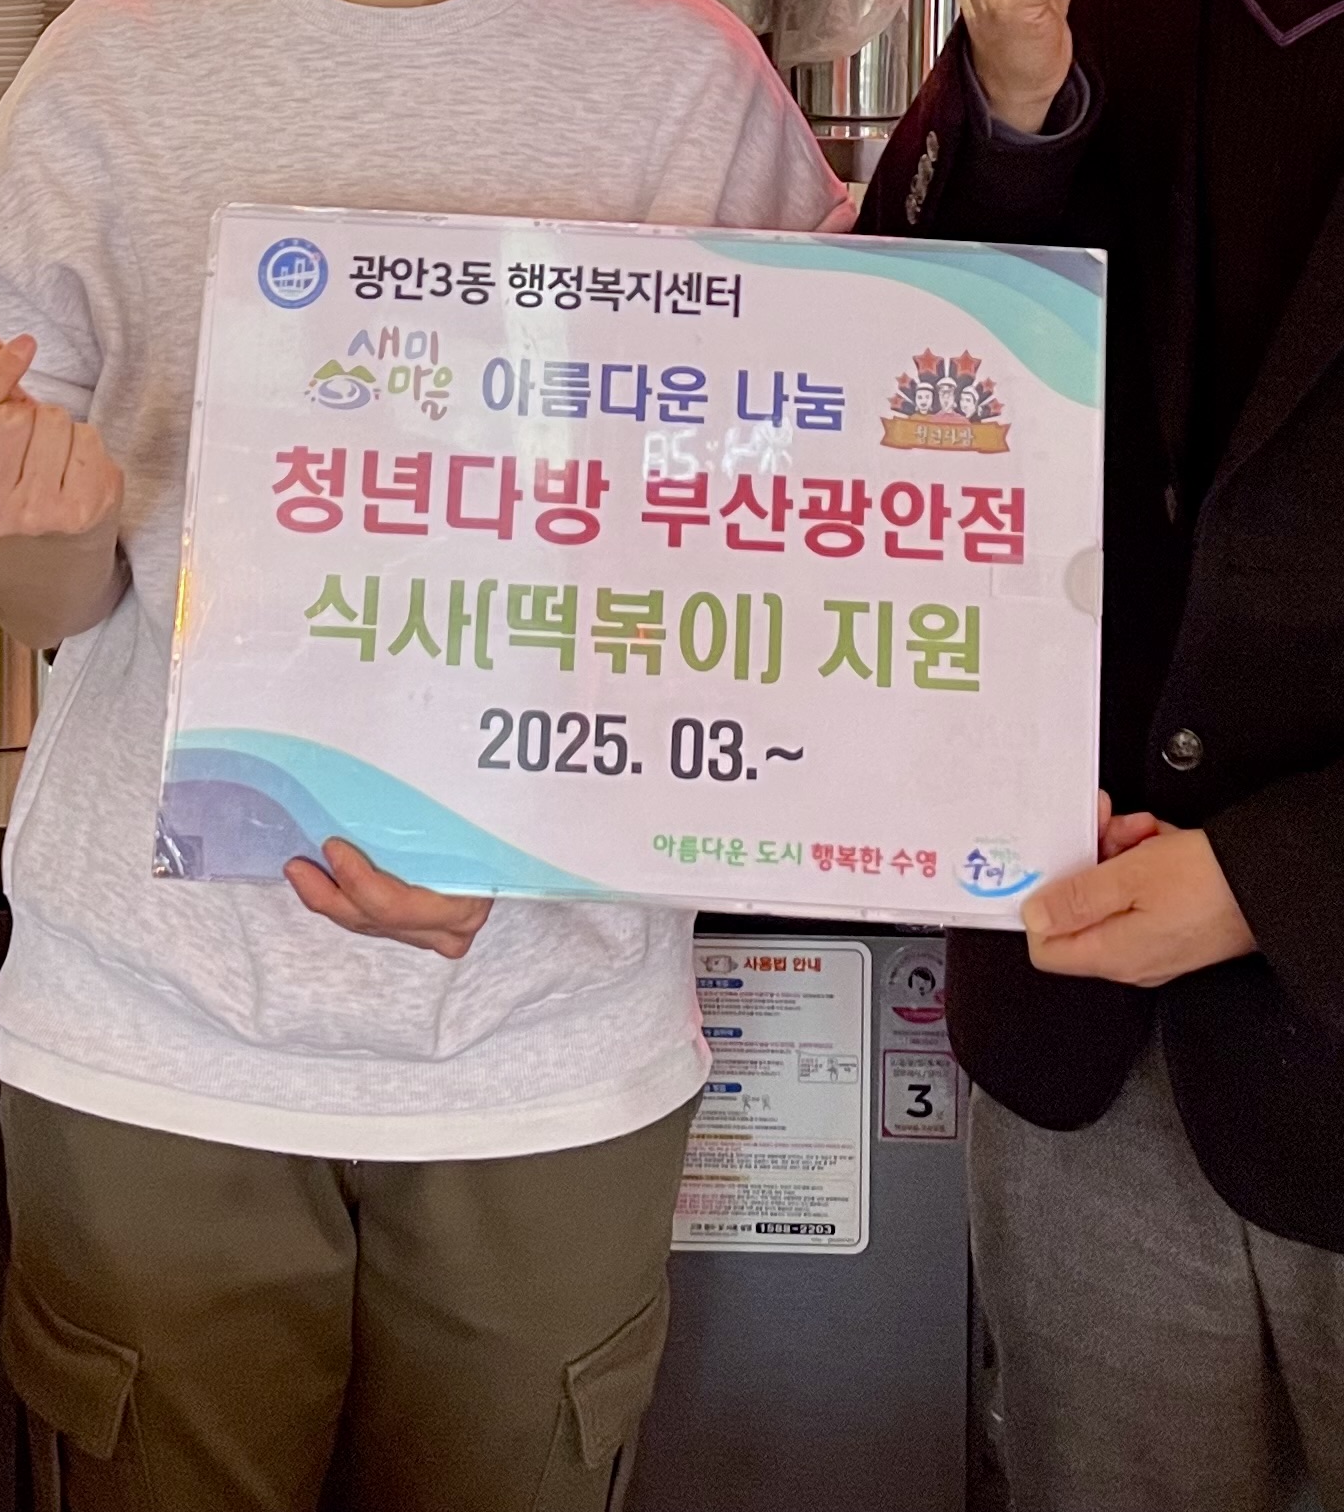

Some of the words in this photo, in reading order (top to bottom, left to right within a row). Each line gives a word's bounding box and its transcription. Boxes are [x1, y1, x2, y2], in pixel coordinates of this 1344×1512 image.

[349, 254, 496, 305] 광안3동
[507, 261, 742, 318] 행정복지센터
[347, 325, 439, 366] 새미
[387, 364, 453, 421] 마을
[482, 357, 709, 425] 아름다운
[737, 368, 846, 432] 나눔
[271, 445, 611, 546] 청년다방
[641, 471, 1027, 565] 부산광안점
[817, 598, 981, 692] 지원
[478, 707, 643, 776] 2025.
[670, 717, 804, 782] 03.~
[652, 833, 748, 866] 아름다운
[756, 839, 803, 866] 도시
[811, 842, 884, 875] 행복한
[889, 848, 938, 879] 수영
[743, 956, 787, 972] 사용법
[792, 956, 822, 973] 안내
[906, 1084, 933, 1118] 3
